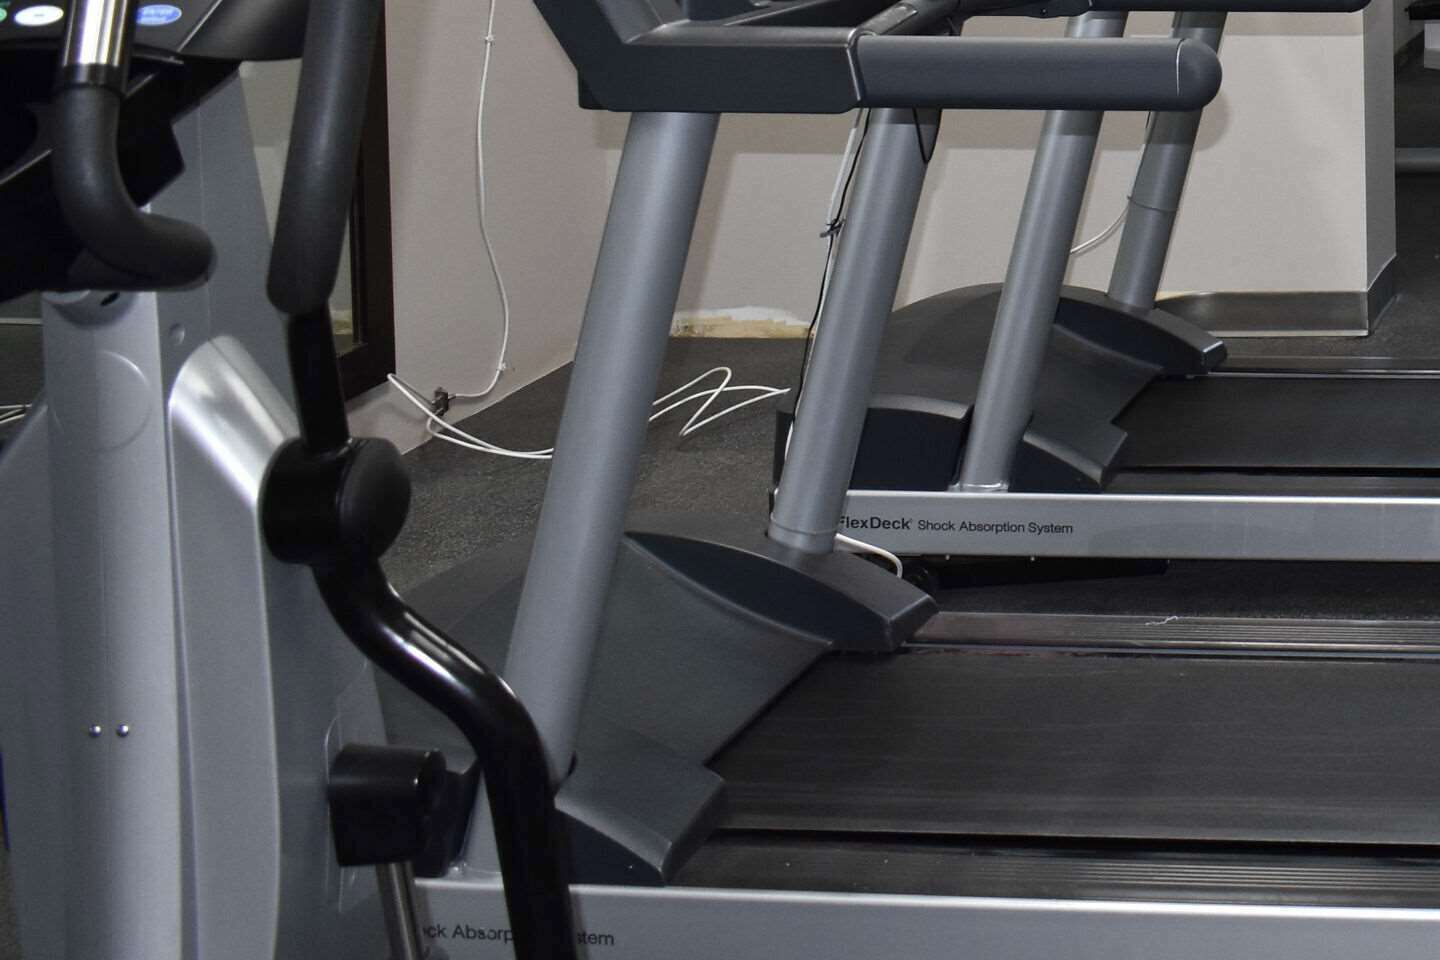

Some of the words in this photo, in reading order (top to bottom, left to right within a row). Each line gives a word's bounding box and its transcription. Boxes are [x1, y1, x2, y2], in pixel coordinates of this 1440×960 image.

[918, 519, 954, 532] Shock
[960, 521, 1025, 536] Absorption
[1028, 522, 1073, 536] System
